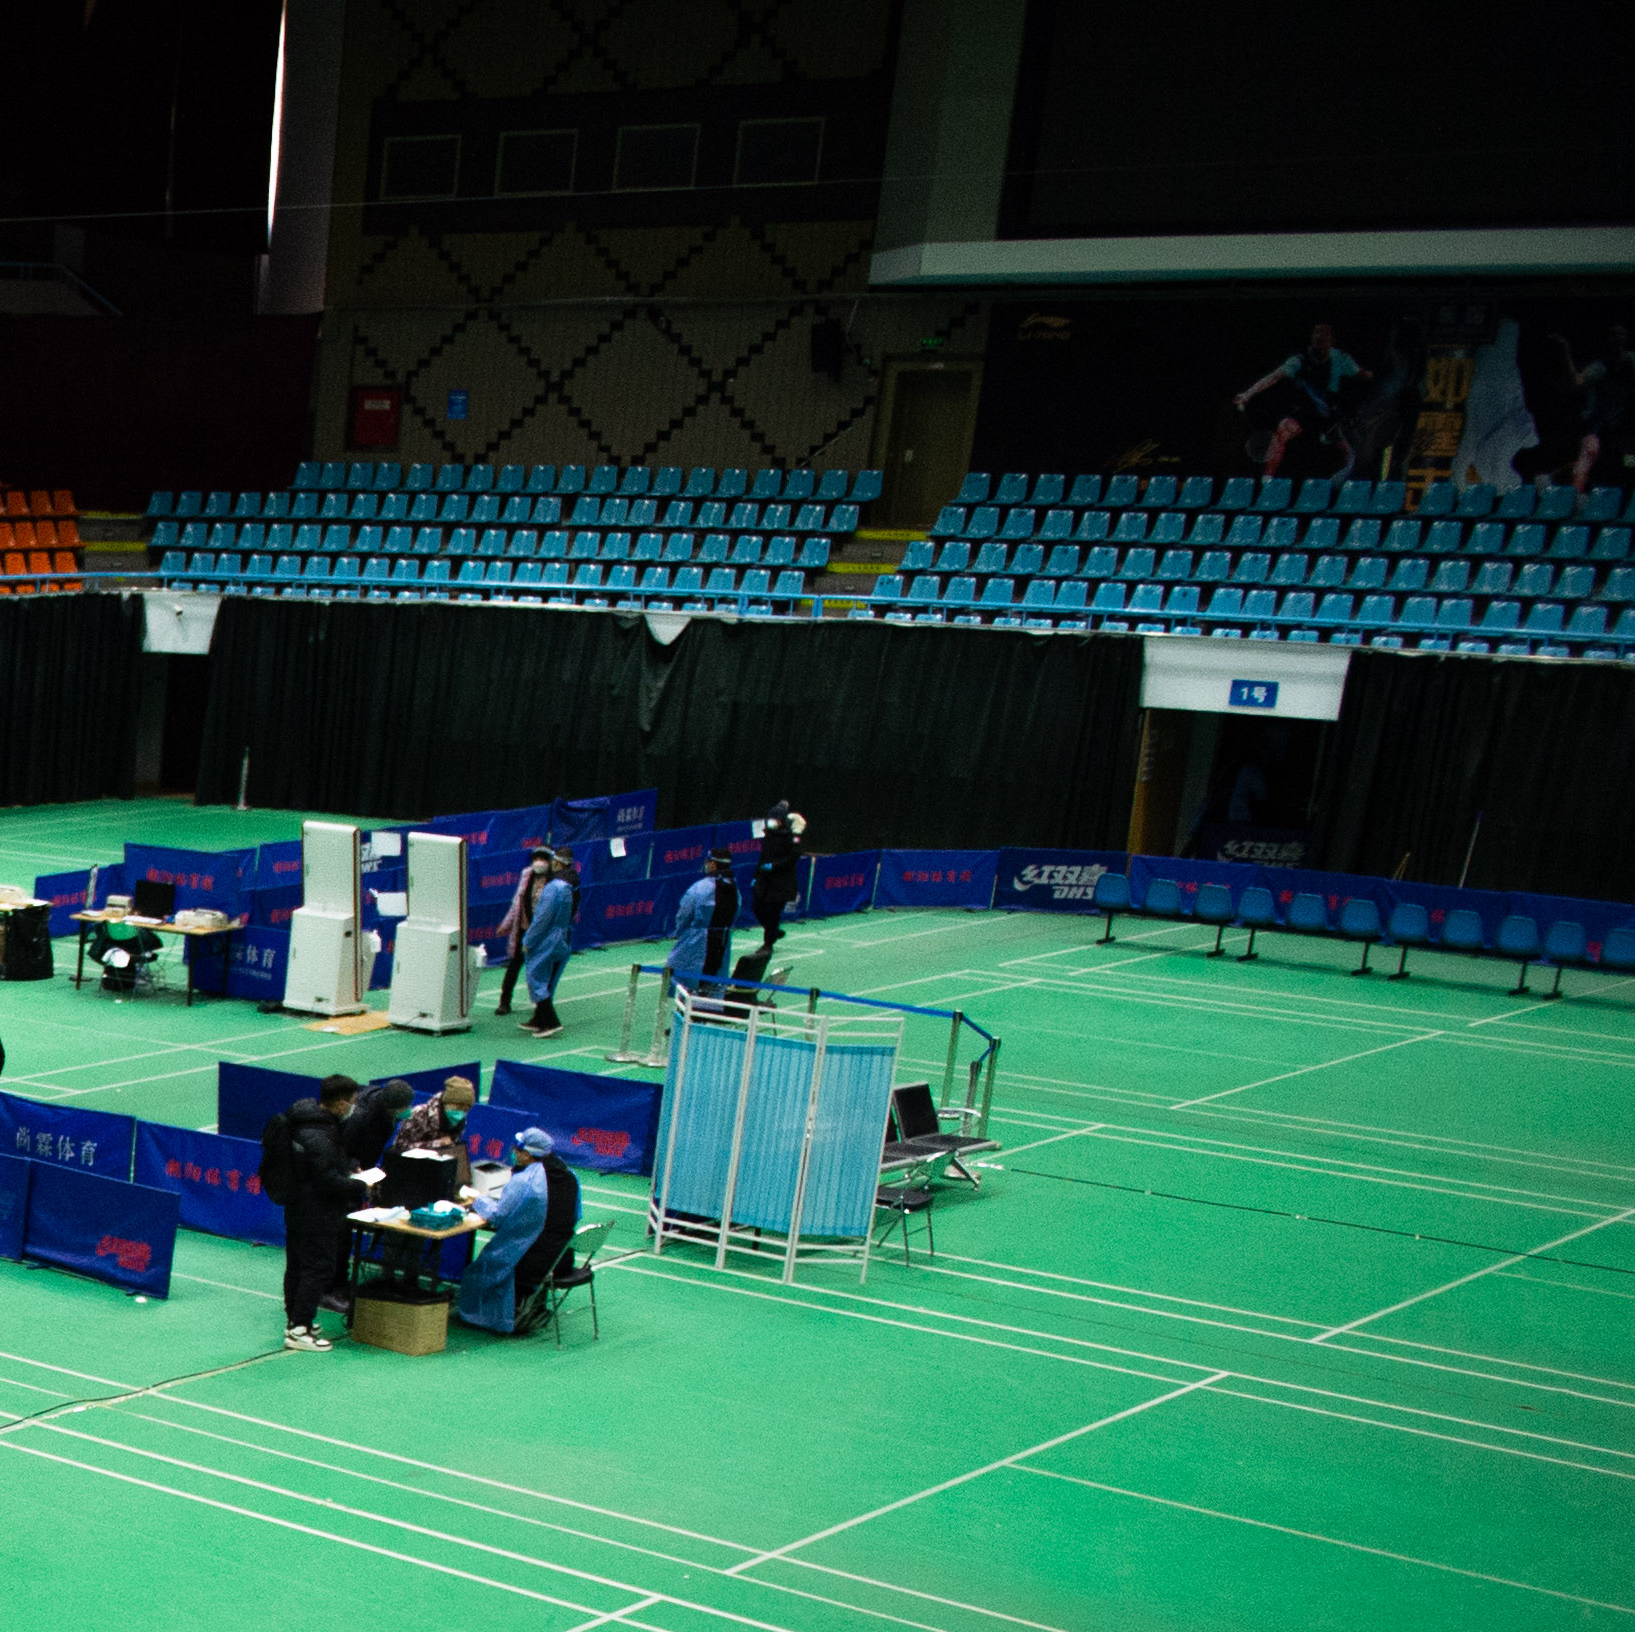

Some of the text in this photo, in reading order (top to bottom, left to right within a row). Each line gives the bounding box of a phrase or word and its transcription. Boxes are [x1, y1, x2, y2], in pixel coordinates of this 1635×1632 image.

[1239, 685, 1269, 703] 1号
[16, 1125, 99, 1168] 尚霖体育
